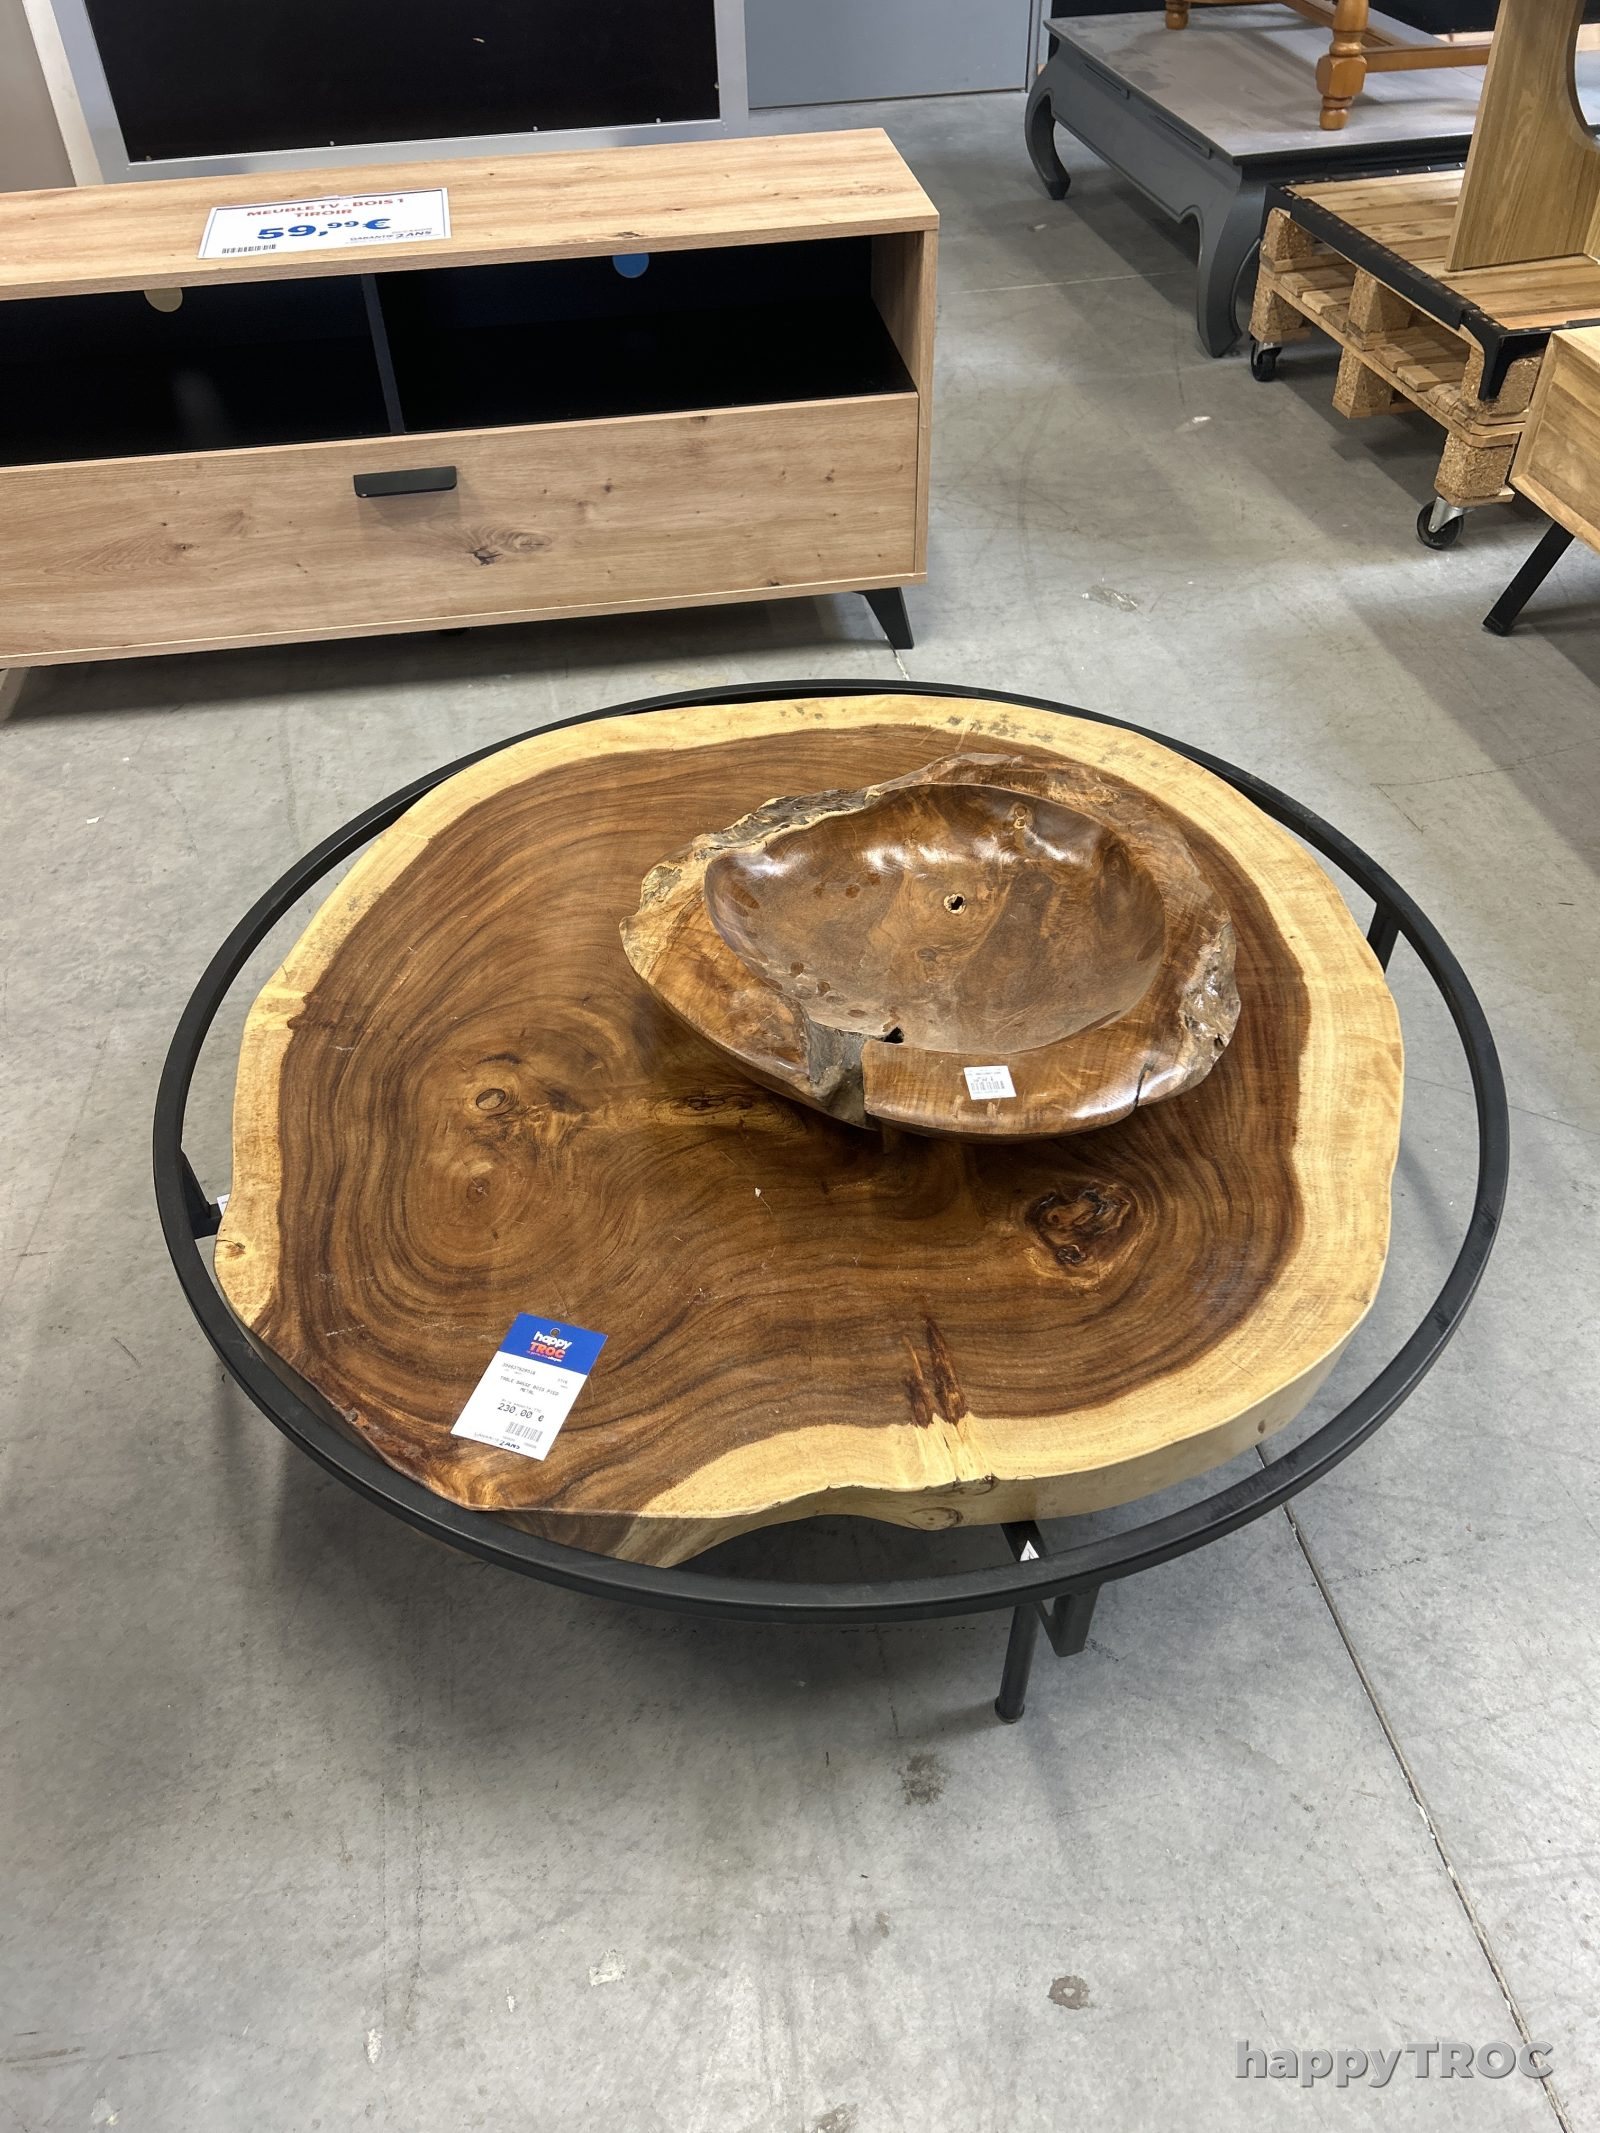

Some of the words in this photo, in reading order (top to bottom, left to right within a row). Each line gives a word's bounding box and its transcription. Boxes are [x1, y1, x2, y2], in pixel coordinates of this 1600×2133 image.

[247, 206, 315, 216] MEUBLE
[294, 209, 352, 218] TIROIR
[533, 1331, 573, 1350] happy
[529, 1341, 566, 1359] TROC
